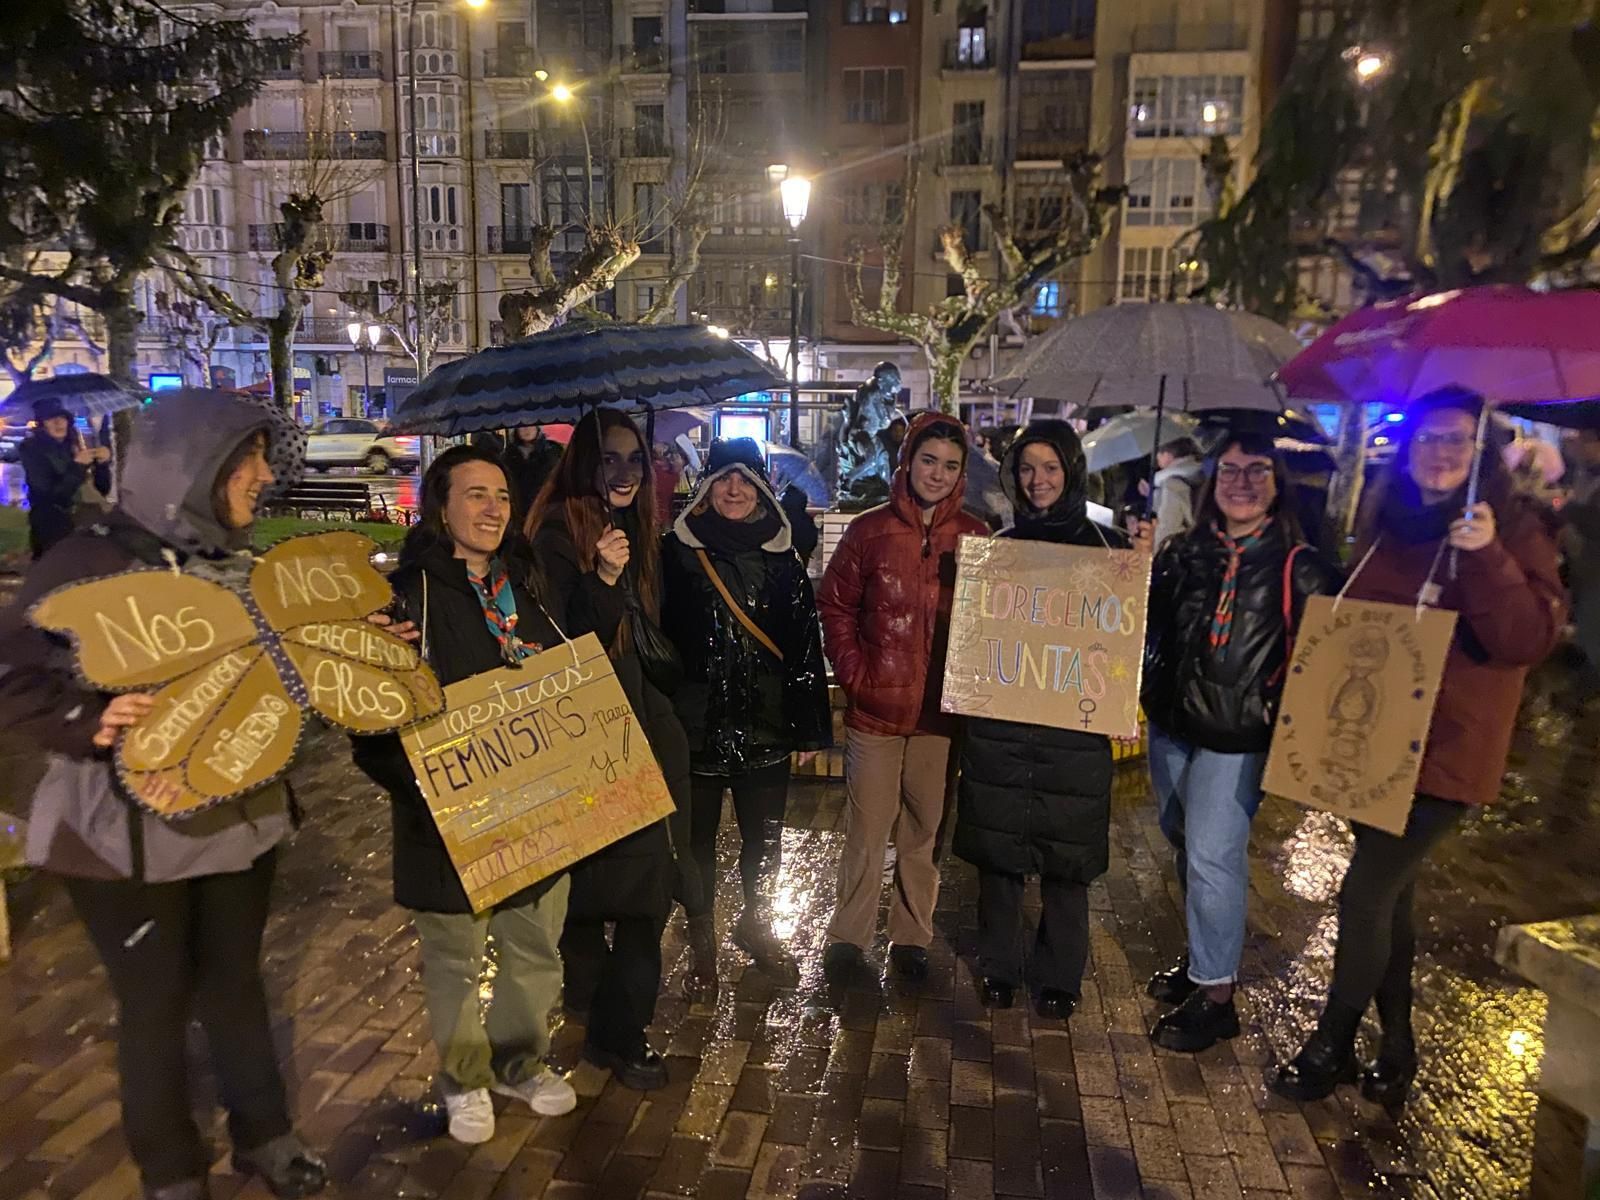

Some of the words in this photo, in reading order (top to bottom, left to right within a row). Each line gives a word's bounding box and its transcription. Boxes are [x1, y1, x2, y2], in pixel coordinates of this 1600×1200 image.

[958, 576, 1136, 636] FLORECEMOS
[974, 637, 1108, 700] JUNTAS
[590, 702, 632, 738] para
